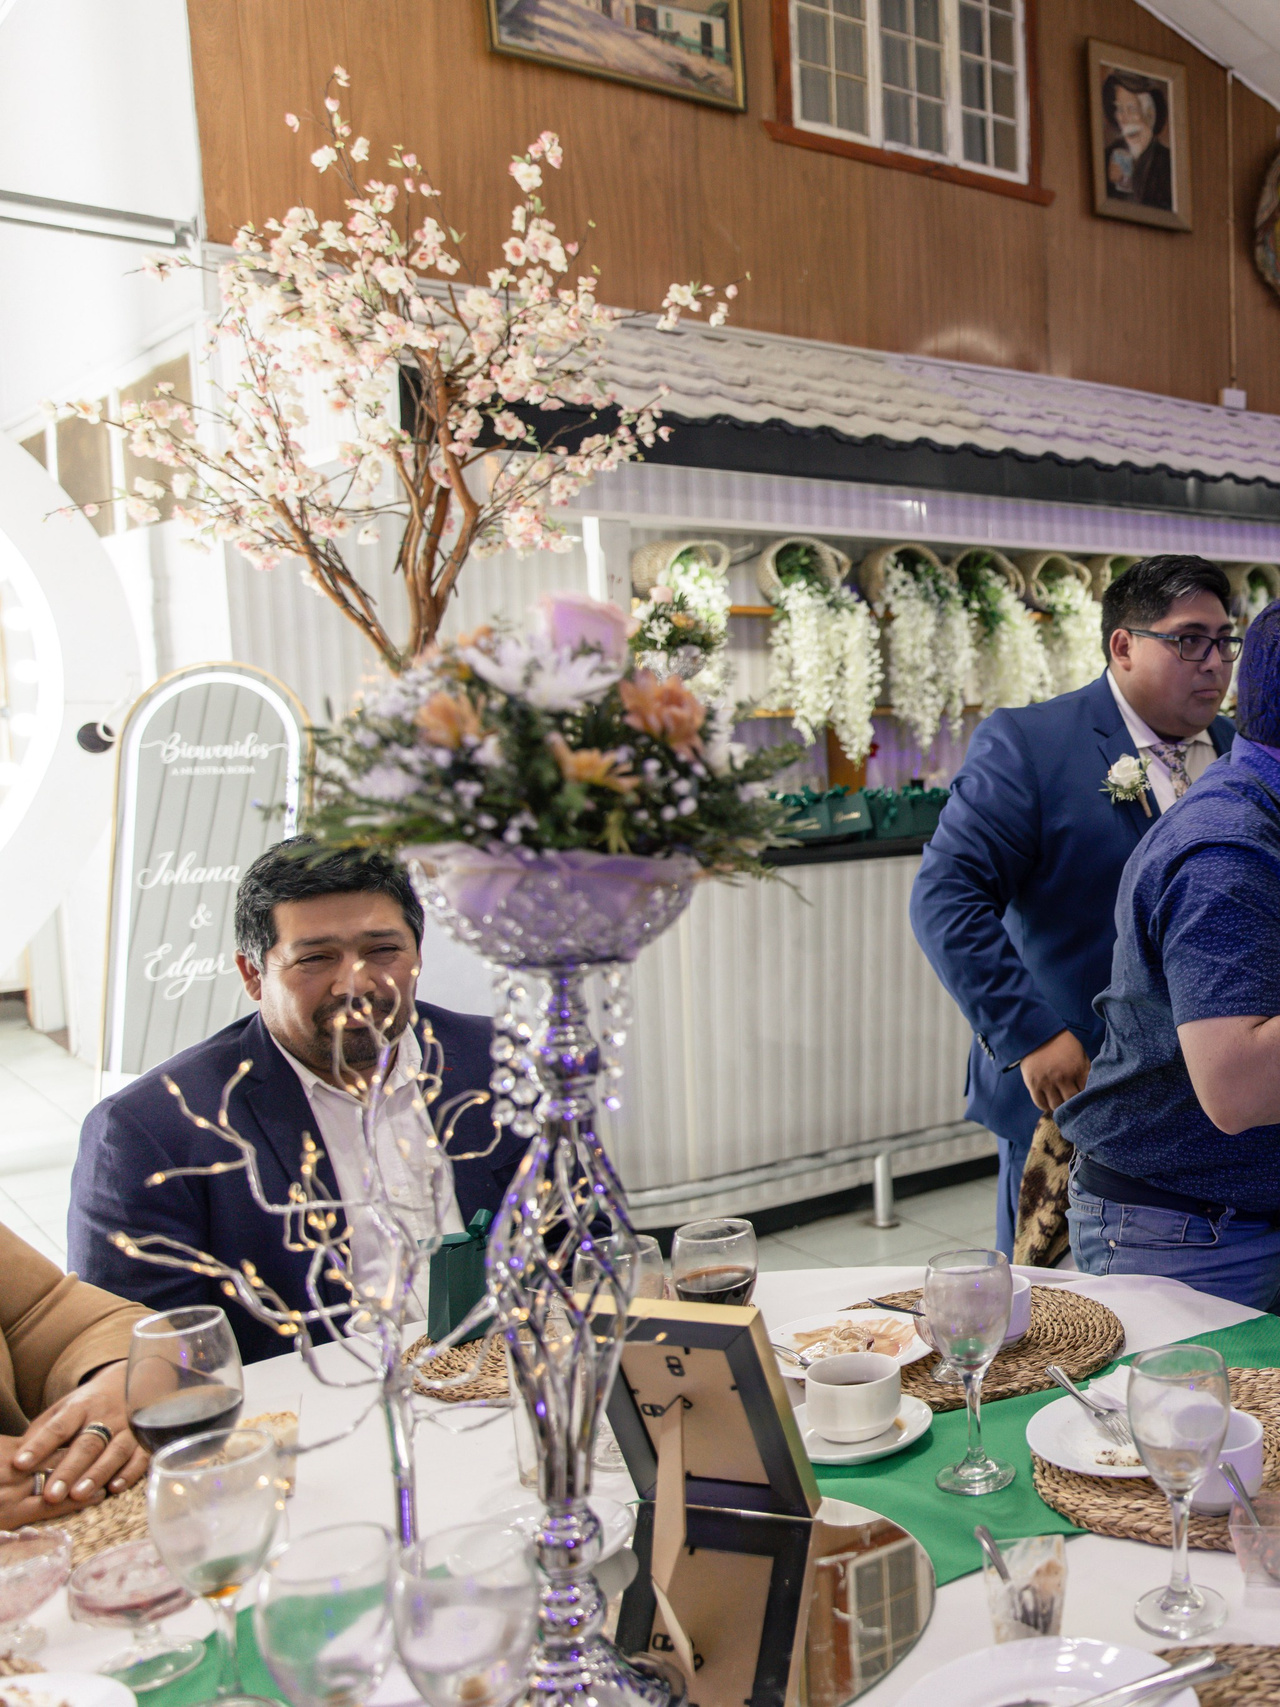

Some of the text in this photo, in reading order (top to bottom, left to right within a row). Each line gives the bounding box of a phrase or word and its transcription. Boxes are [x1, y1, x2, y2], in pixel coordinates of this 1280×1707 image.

[141, 732, 286, 764] Bienvenidos
[171, 764, 256, 775] A NUESTRA BODA
[137, 851, 242, 889] Johana
[190, 903, 214, 929] &
[143, 942, 238, 1000] Edgar
